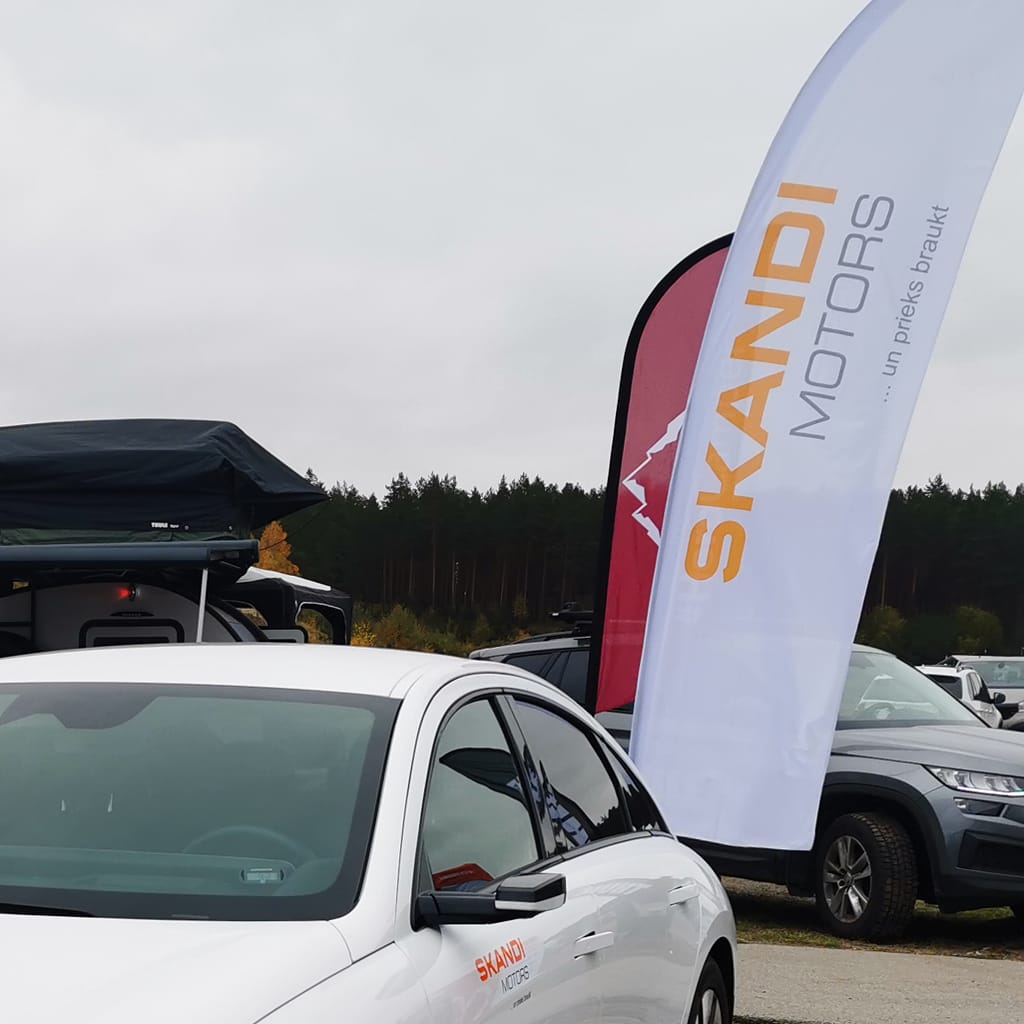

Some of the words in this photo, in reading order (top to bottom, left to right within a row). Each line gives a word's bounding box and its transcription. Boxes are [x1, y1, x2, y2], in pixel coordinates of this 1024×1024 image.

[684, 182, 838, 583] SKANDI
[789, 194, 895, 440] MOTORS
[882, 350, 902, 377] un
[894, 280, 924, 345] prieks
[910, 205, 950, 274] braukt
[475, 937, 526, 982] SKANDI
